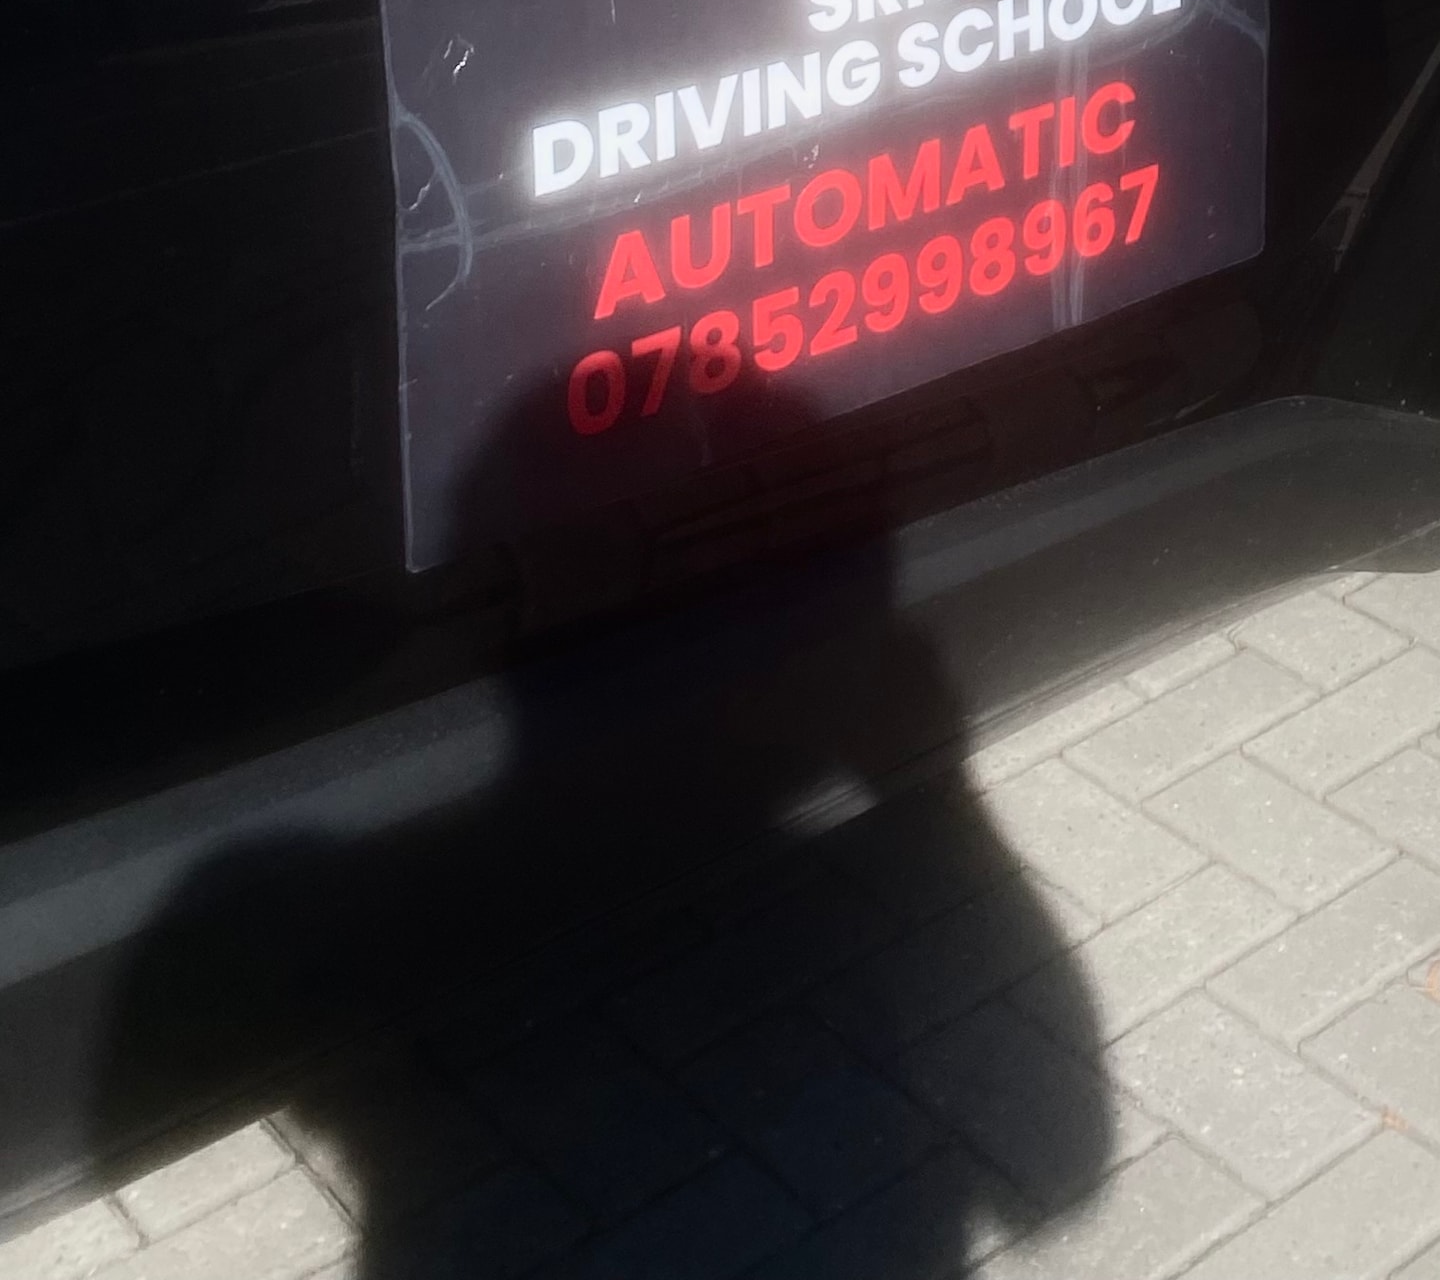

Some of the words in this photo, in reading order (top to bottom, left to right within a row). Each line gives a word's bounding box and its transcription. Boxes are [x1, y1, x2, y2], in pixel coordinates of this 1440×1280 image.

[531, 41, 881, 197] DRIVING
[594, 81, 1137, 320] AUTOMATIC
[566, 164, 1160, 436] 07852998967
